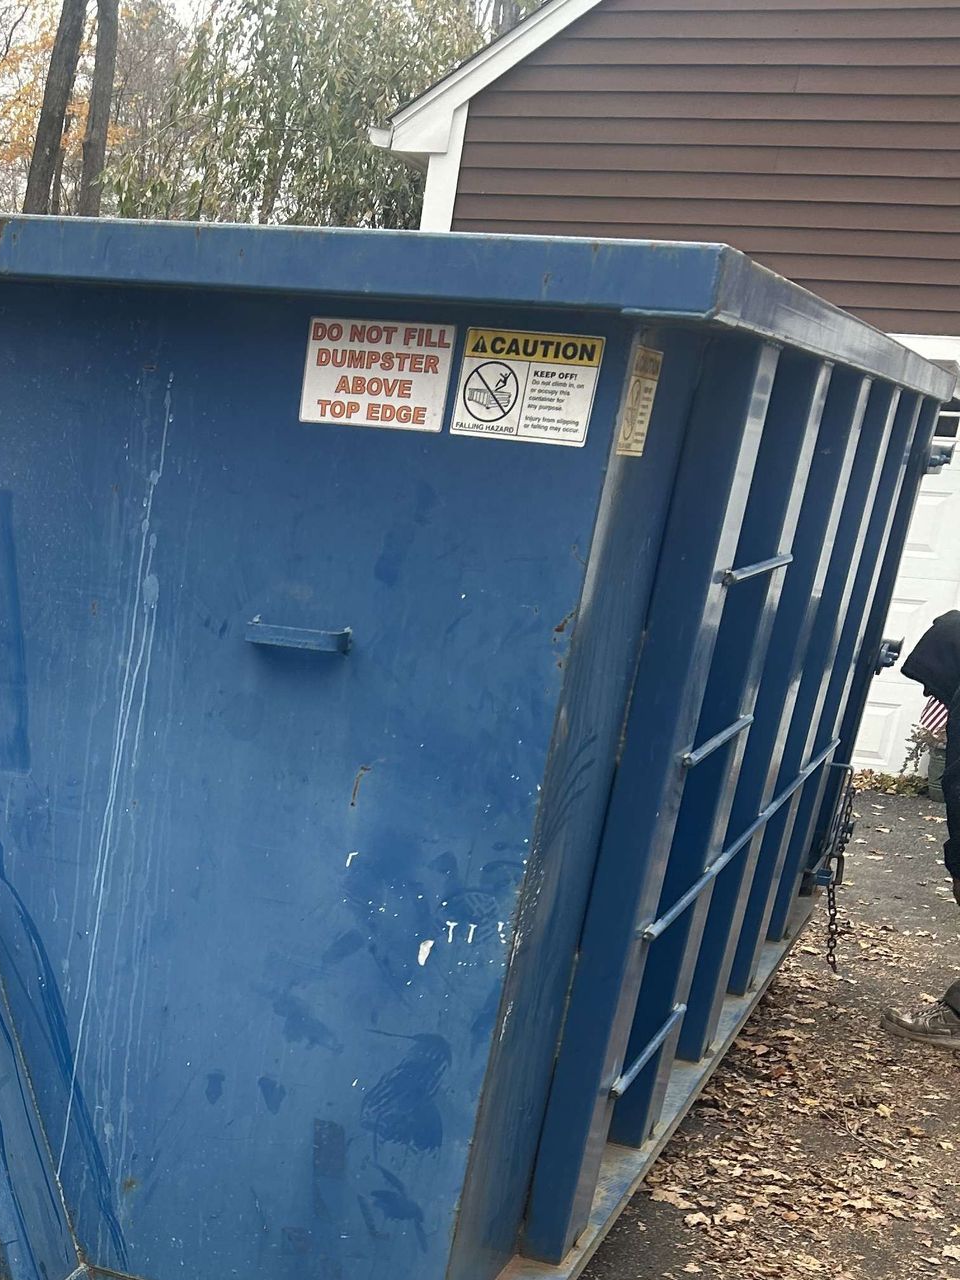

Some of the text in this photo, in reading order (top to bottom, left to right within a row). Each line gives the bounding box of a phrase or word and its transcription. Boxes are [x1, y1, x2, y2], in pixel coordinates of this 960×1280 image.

[312, 322, 451, 348] DO NOT FILL
[316, 348, 440, 374] DUMPSTER
[490, 336, 596, 362] CAUTION
[335, 375, 413, 398] ABOVE
[533, 370, 578, 380] KEEP OFF!
[317, 399, 427, 425] TOP EDGE
[455, 421, 515, 434] FALLING HAZARD
